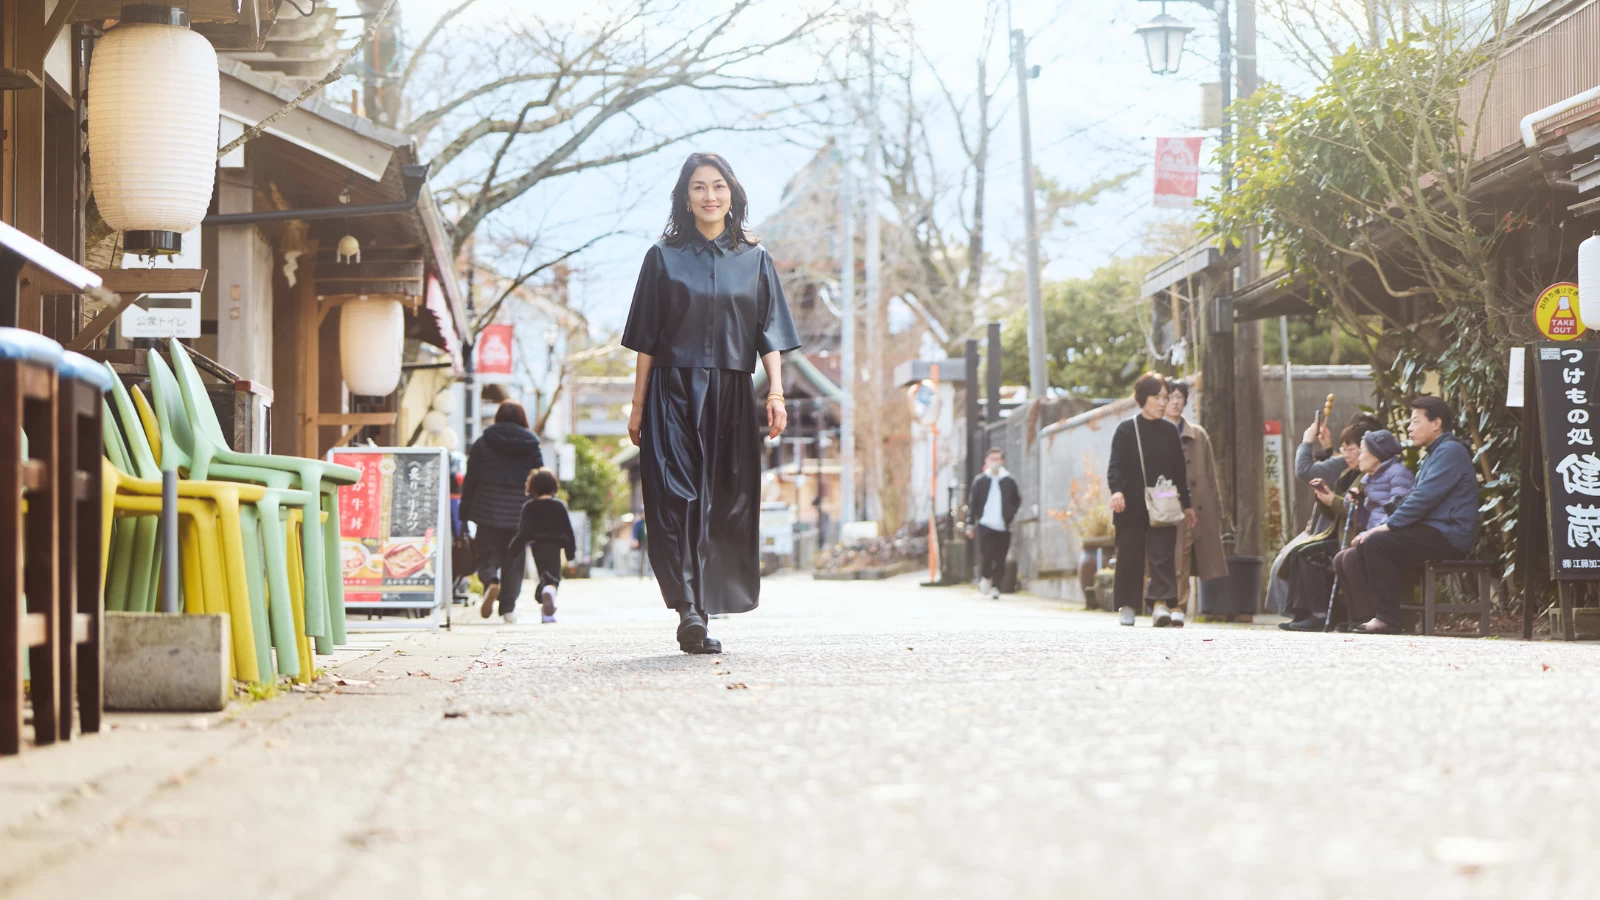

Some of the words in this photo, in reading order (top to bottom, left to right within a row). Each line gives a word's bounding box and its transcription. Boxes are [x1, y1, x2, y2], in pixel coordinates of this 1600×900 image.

[136, 316, 187, 327] 公衆トイレ
[1561, 349, 1593, 445] つけもの処
[1265, 440, 1279, 479] この先
